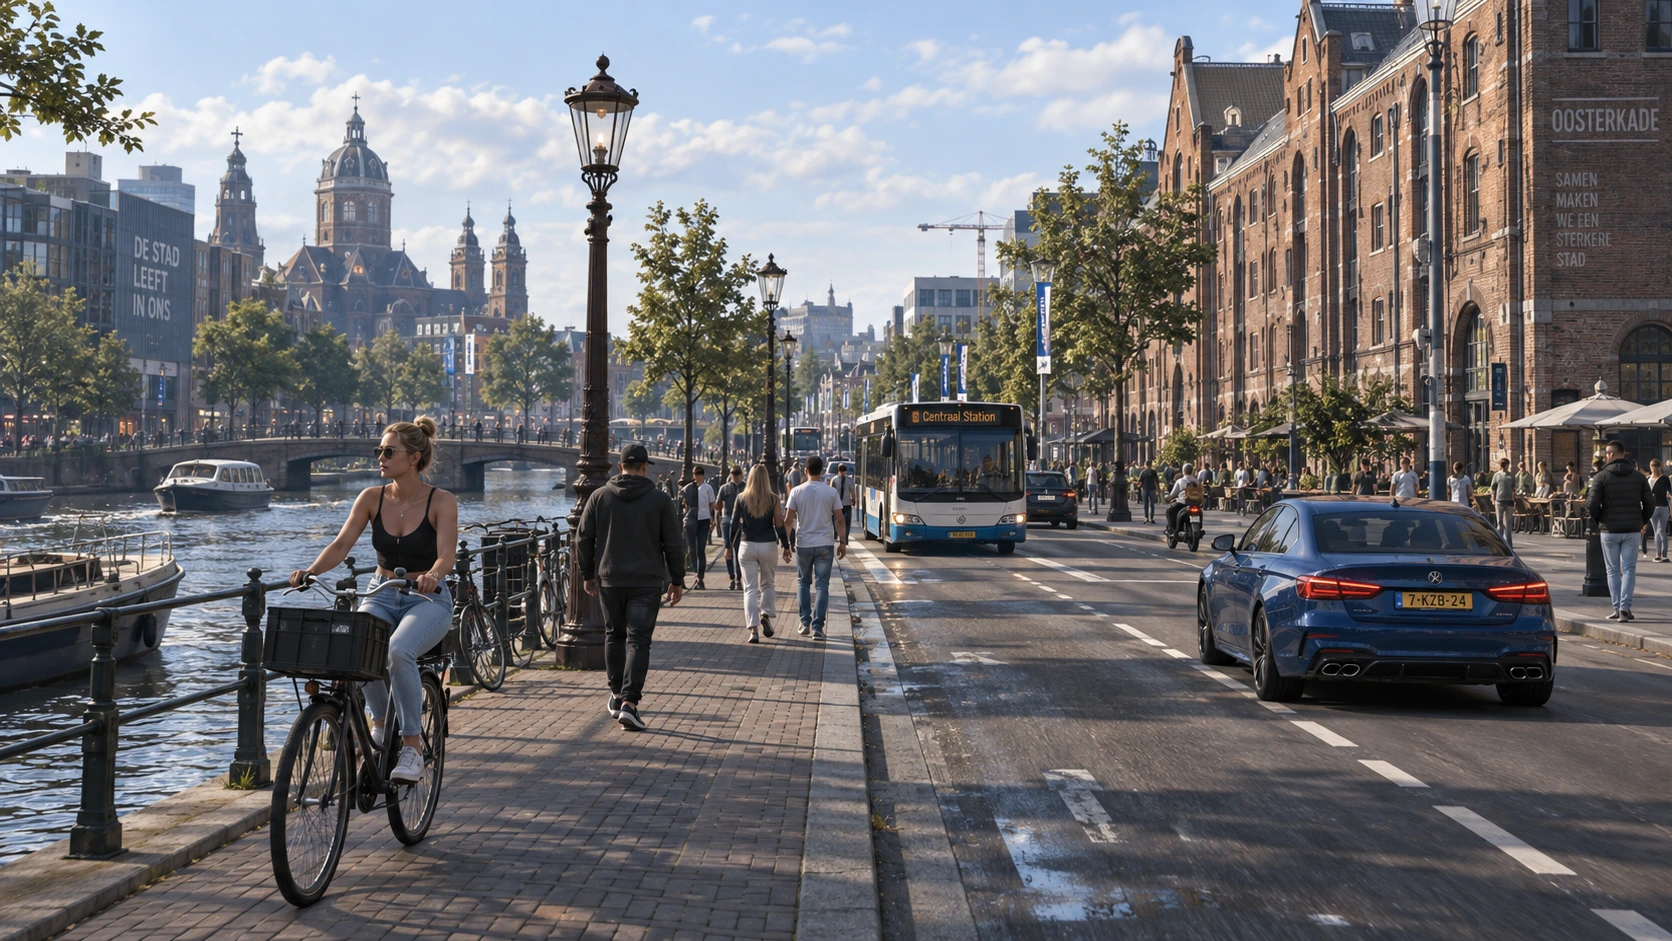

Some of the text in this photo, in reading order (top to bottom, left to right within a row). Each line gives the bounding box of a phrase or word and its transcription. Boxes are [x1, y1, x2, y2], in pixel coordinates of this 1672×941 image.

[1552, 108, 1660, 132] OOSTERKADE
[1556, 172, 1598, 187] SAMEN
[1556, 192, 1598, 208] MAKEN
[1556, 213, 1599, 228] WE EEN
[1556, 232, 1612, 247] STERKERE
[134, 236, 180, 268] DE STAD
[1556, 252, 1586, 267] STAD
[133, 264, 168, 293] LEEFT
[133, 293, 171, 321] IN ONS
[922, 411, 960, 422] Centraal
[963, 411, 996, 422] Station
[1408, 594, 1466, 607] 7-KZB-24
